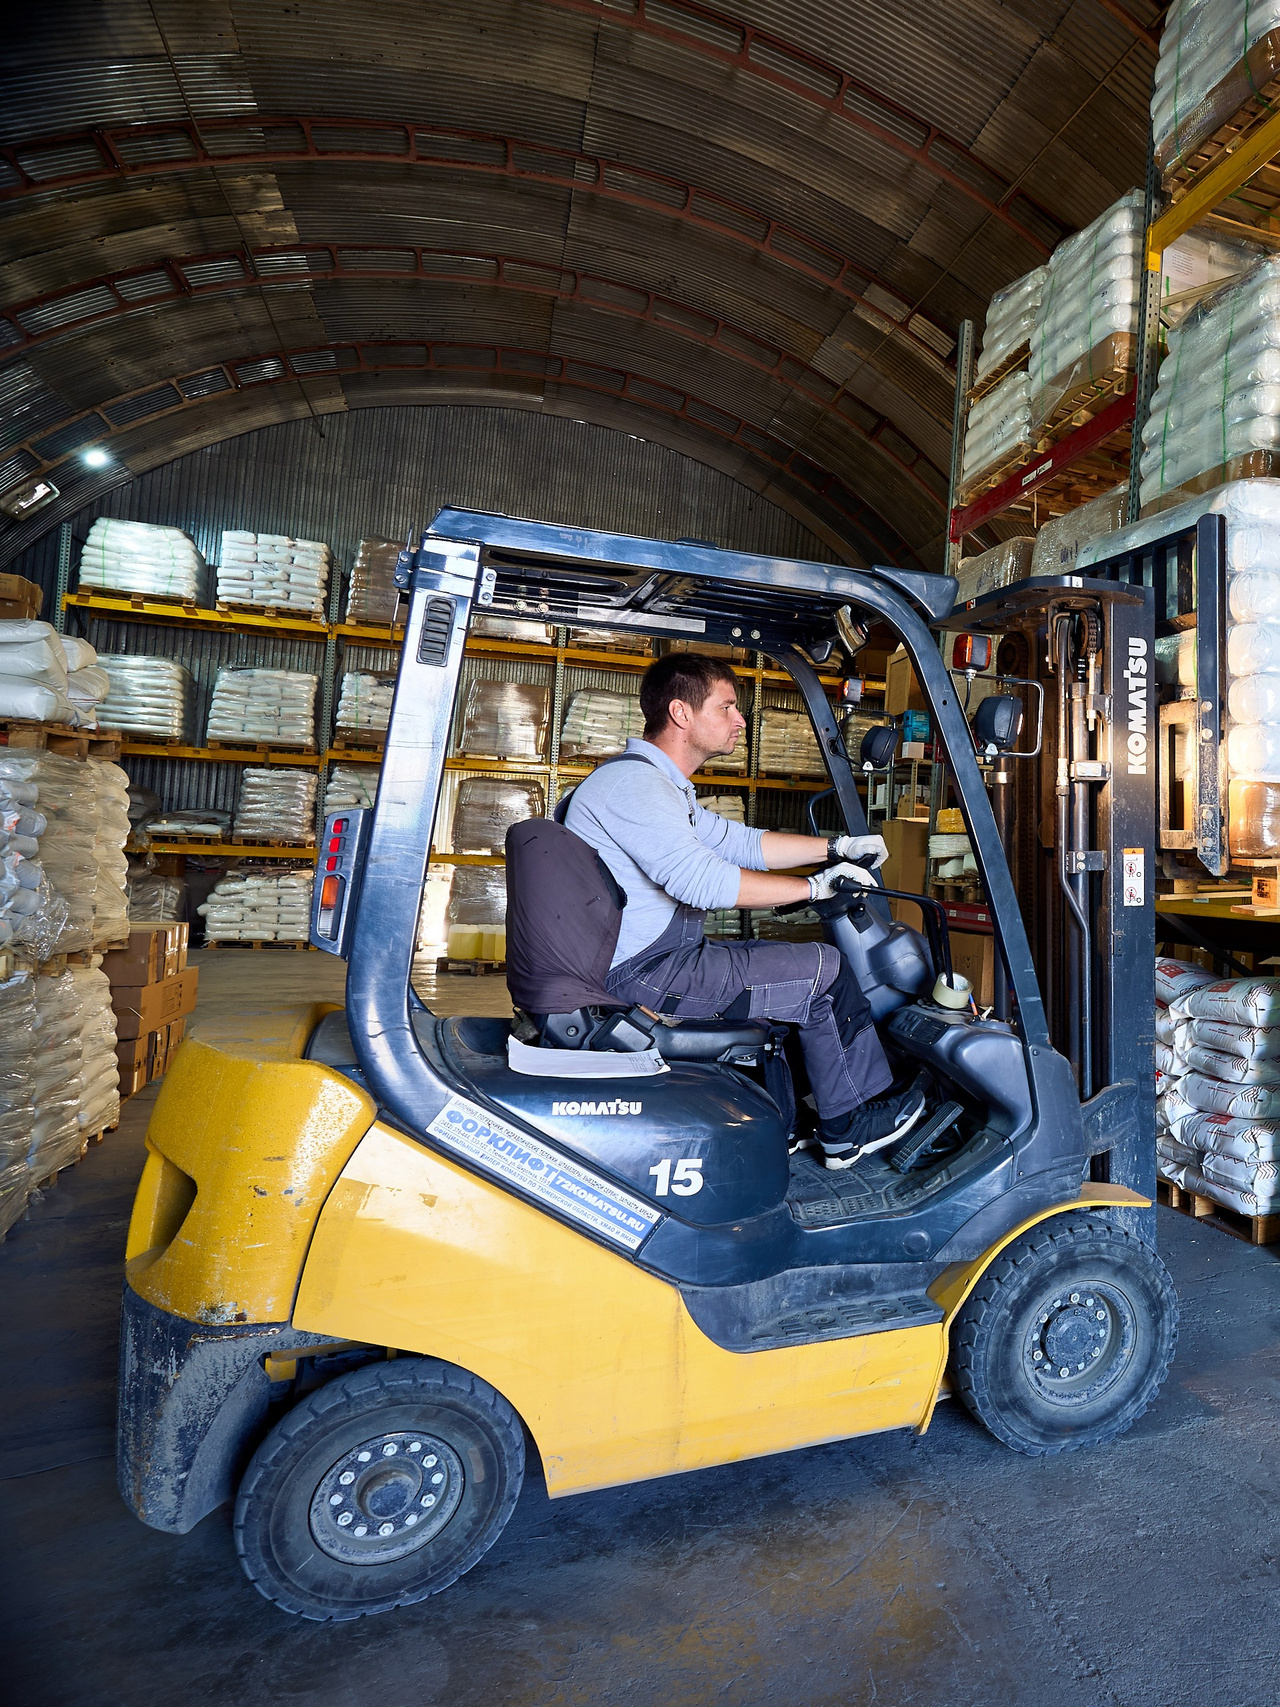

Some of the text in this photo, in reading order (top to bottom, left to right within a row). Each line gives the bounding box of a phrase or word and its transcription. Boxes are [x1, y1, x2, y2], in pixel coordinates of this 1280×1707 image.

[1123, 637, 1148, 775] KOMATSU
[552, 1098, 642, 1116] KOMATSU
[441, 1106, 560, 1181] ФОРКЛИФТ
[432, 1125, 481, 1156] ОФИЦИАЛЬНЫЙ
[479, 1152, 501, 1168] ДИЛЕР
[498, 1163, 528, 1183] KOMATSU
[535, 1184, 573, 1209] ТЮМЕНСКОЙ
[570, 1204, 600, 1225] ОБЛАСТИ,
[598, 1220, 616, 1233] ХМАО
[619, 1232, 636, 1245] ЯНАО
[553, 1174, 646, 1233] 72KOMATSU.RU
[649, 1158, 704, 1197] 15
